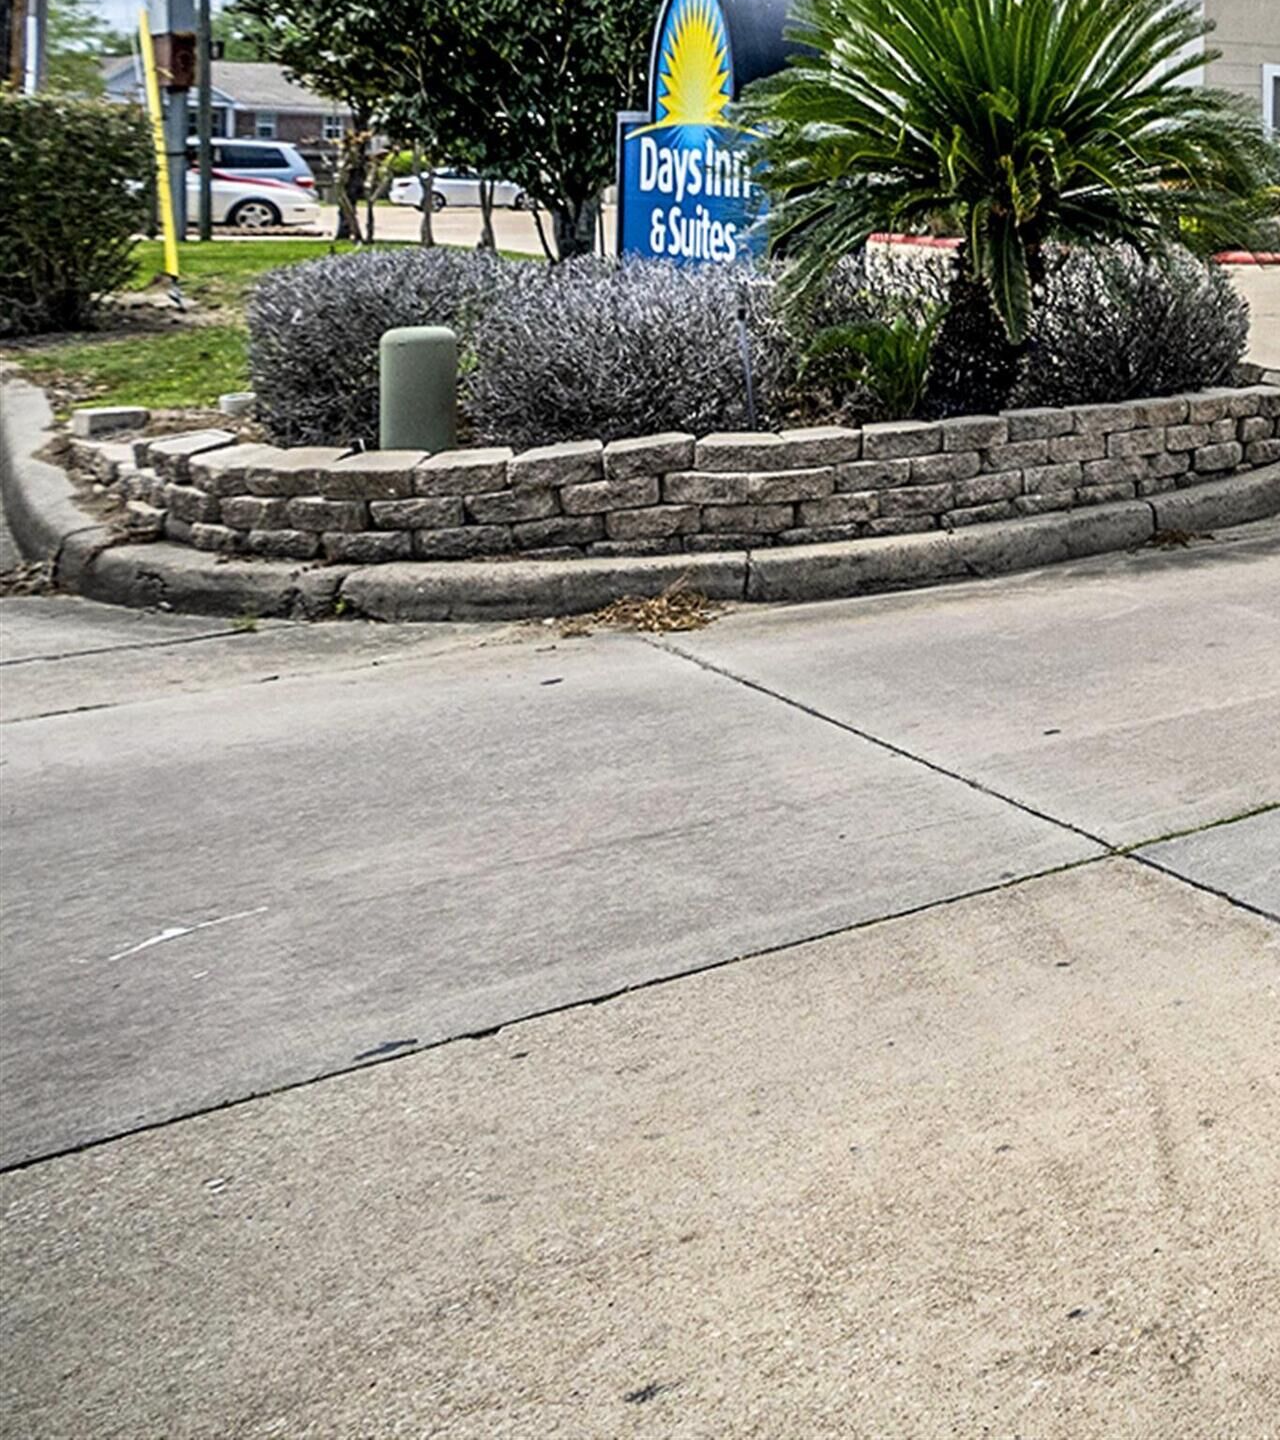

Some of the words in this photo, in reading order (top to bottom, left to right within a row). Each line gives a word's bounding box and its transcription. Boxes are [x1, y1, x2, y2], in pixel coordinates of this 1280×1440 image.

[640, 137, 702, 202] Days
[704, 138, 751, 198] Inn
[650, 208, 666, 253] &
[667, 204, 737, 261] Suites
